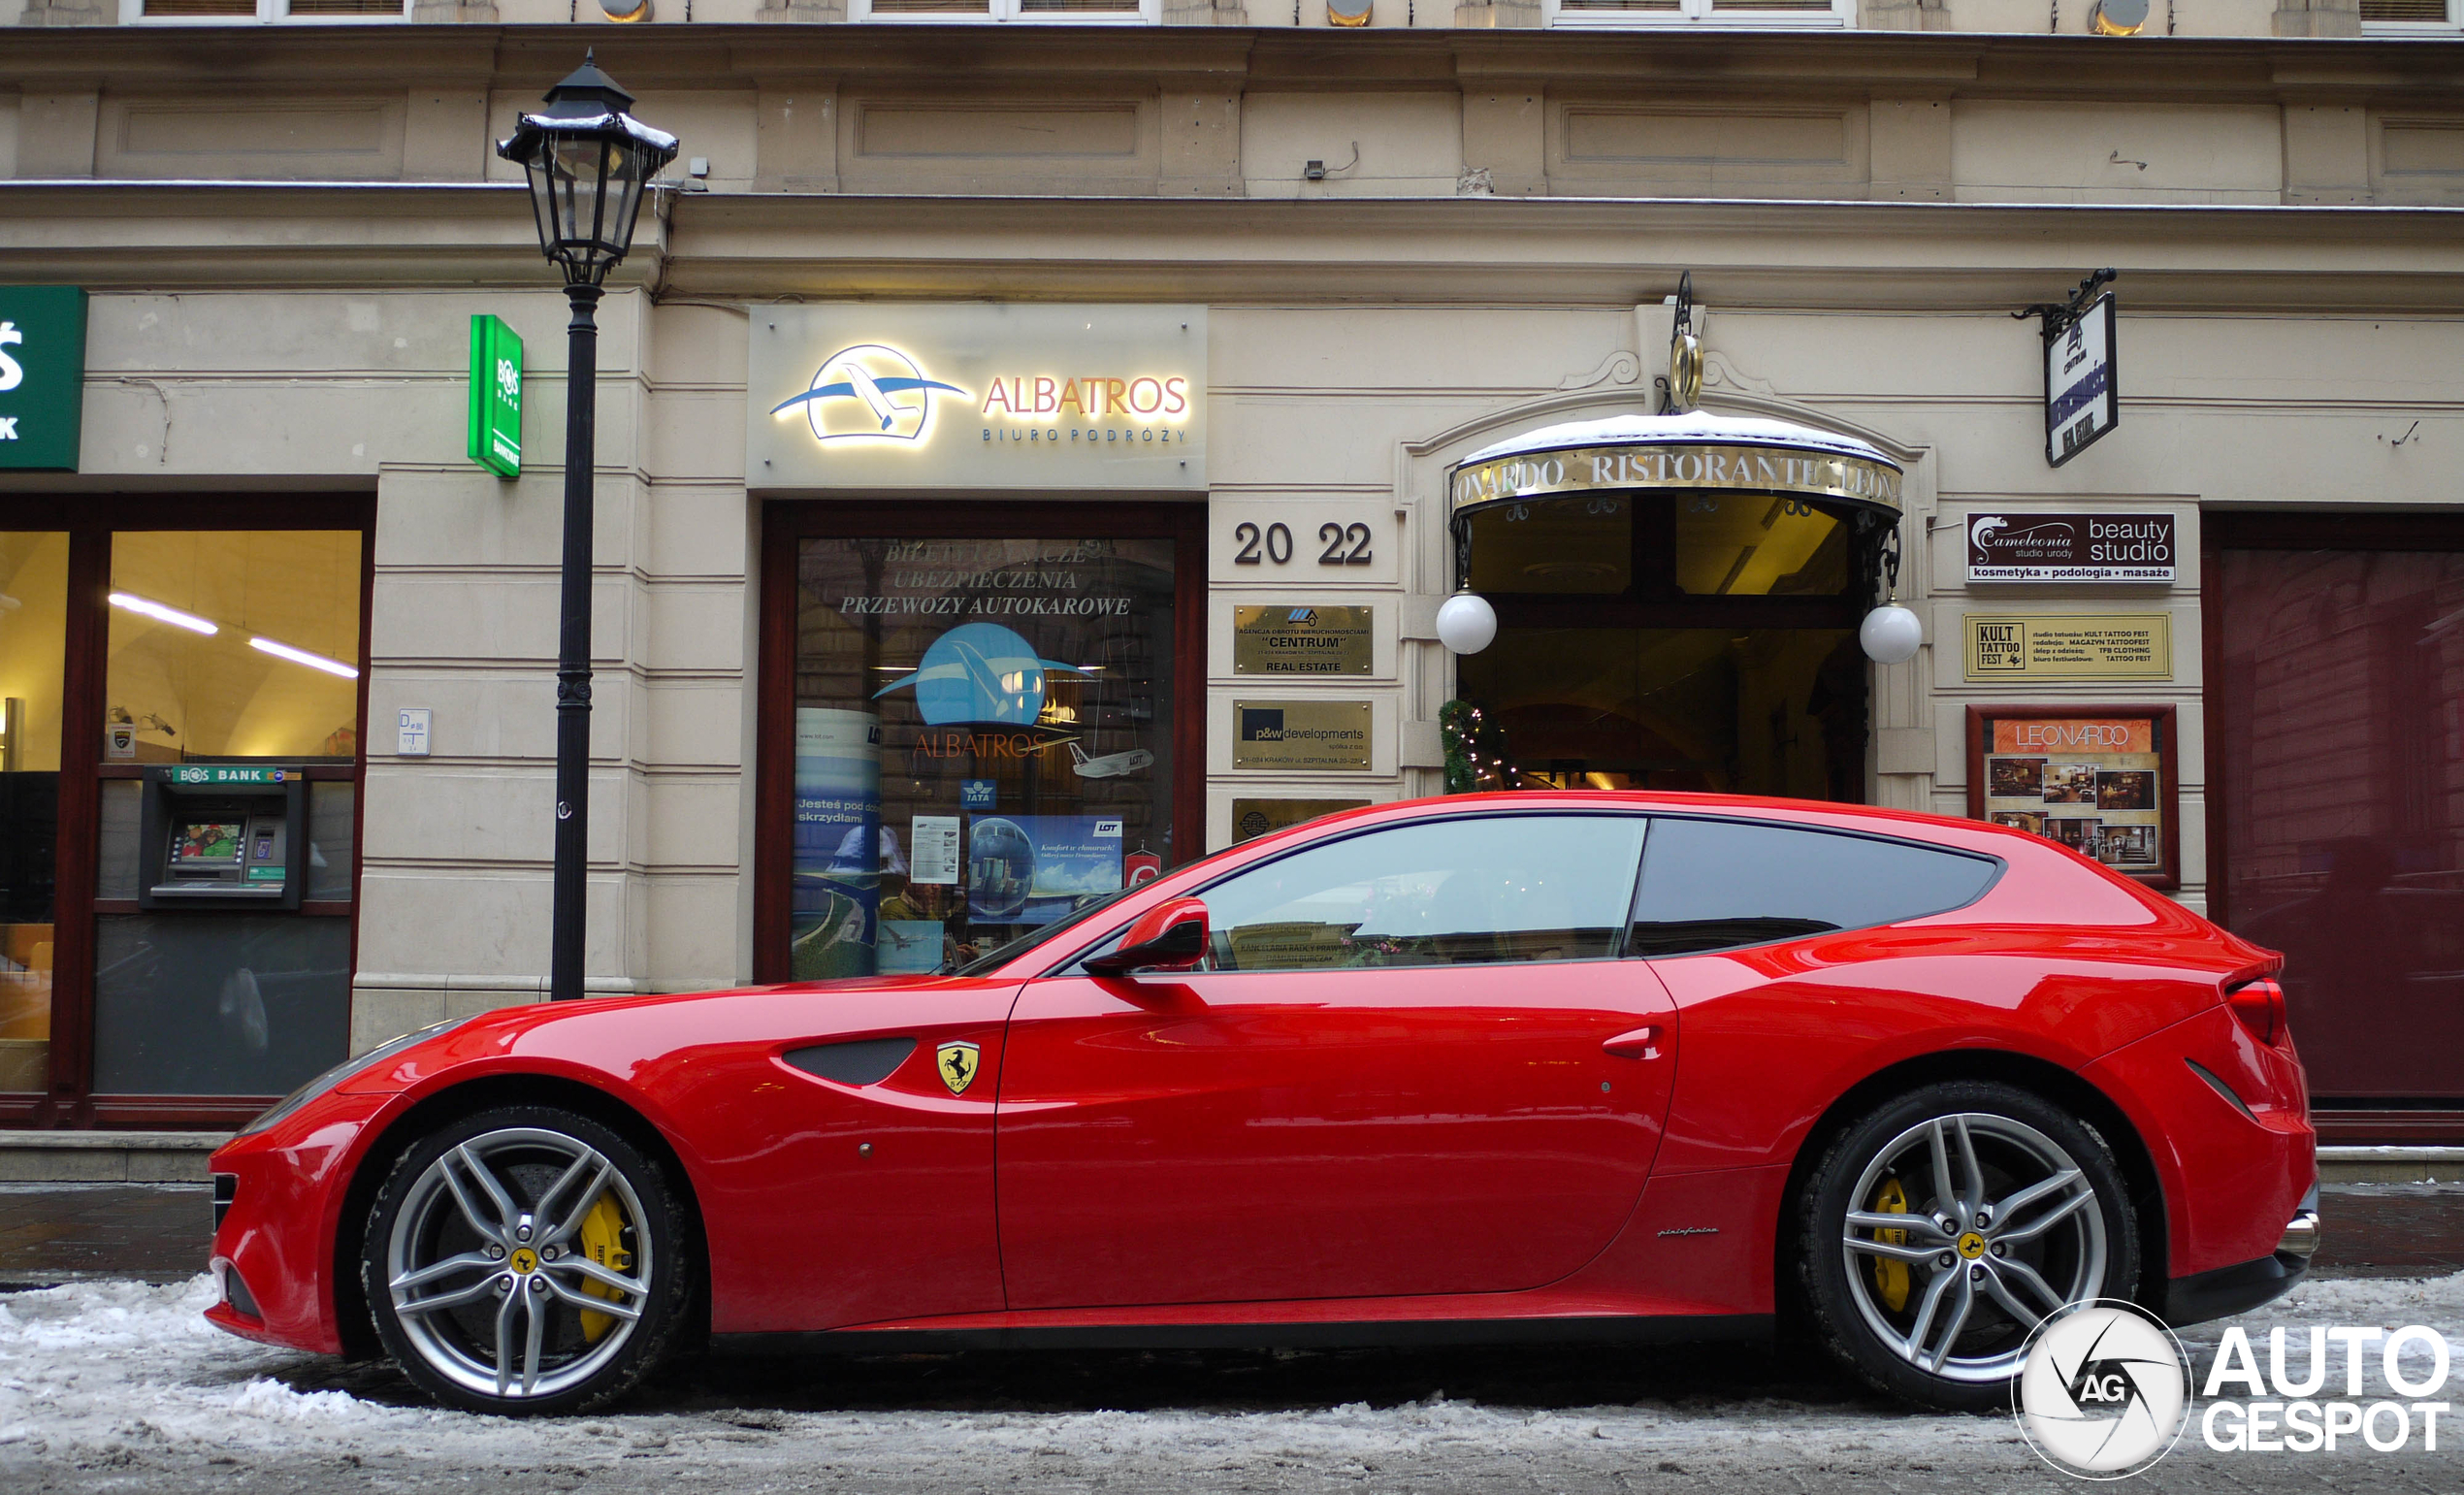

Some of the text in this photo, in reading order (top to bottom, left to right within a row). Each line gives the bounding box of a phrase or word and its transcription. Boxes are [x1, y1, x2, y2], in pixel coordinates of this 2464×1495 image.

[498, 358, 519, 395] BOŚ
[983, 376, 1185, 414] ALBATROS
[983, 426, 1185, 441] BIURO PODRÓŻY
[1456, 459, 1564, 504] ONARDO
[1592, 453, 1821, 485] RISTORANTE
[1980, 530, 2072, 547] Cameleonia
[2090, 519, 2169, 543] beauty
[1234, 522, 1372, 564] 20 22
[2091, 540, 2168, 561] studio
[2015, 549, 2073, 560] studio urody
[894, 570, 1078, 589] UBEZPIECZENIA
[1974, 568, 2170, 579] kosmetyka podologia masaże
[840, 597, 1130, 616] PRZEWOZY AUTOKAROWE
[1980, 626, 2014, 641] KULT
[1980, 642, 2020, 653] TATTOO
[1266, 663, 1342, 671] REAL ESTATE
[1981, 654, 2002, 665] FEST
[2016, 726, 2129, 746] LEONARDO
[913, 733, 1047, 759] ALBATROS
[1129, 754, 1144, 766] LOT
[180, 767, 210, 783] BOŚ
[218, 770, 261, 781] BANK
[798, 799, 841, 809] Jesteś
[844, 801, 863, 812] pod
[966, 794, 989, 802] IATA
[798, 812, 863, 824] skrzydłami
